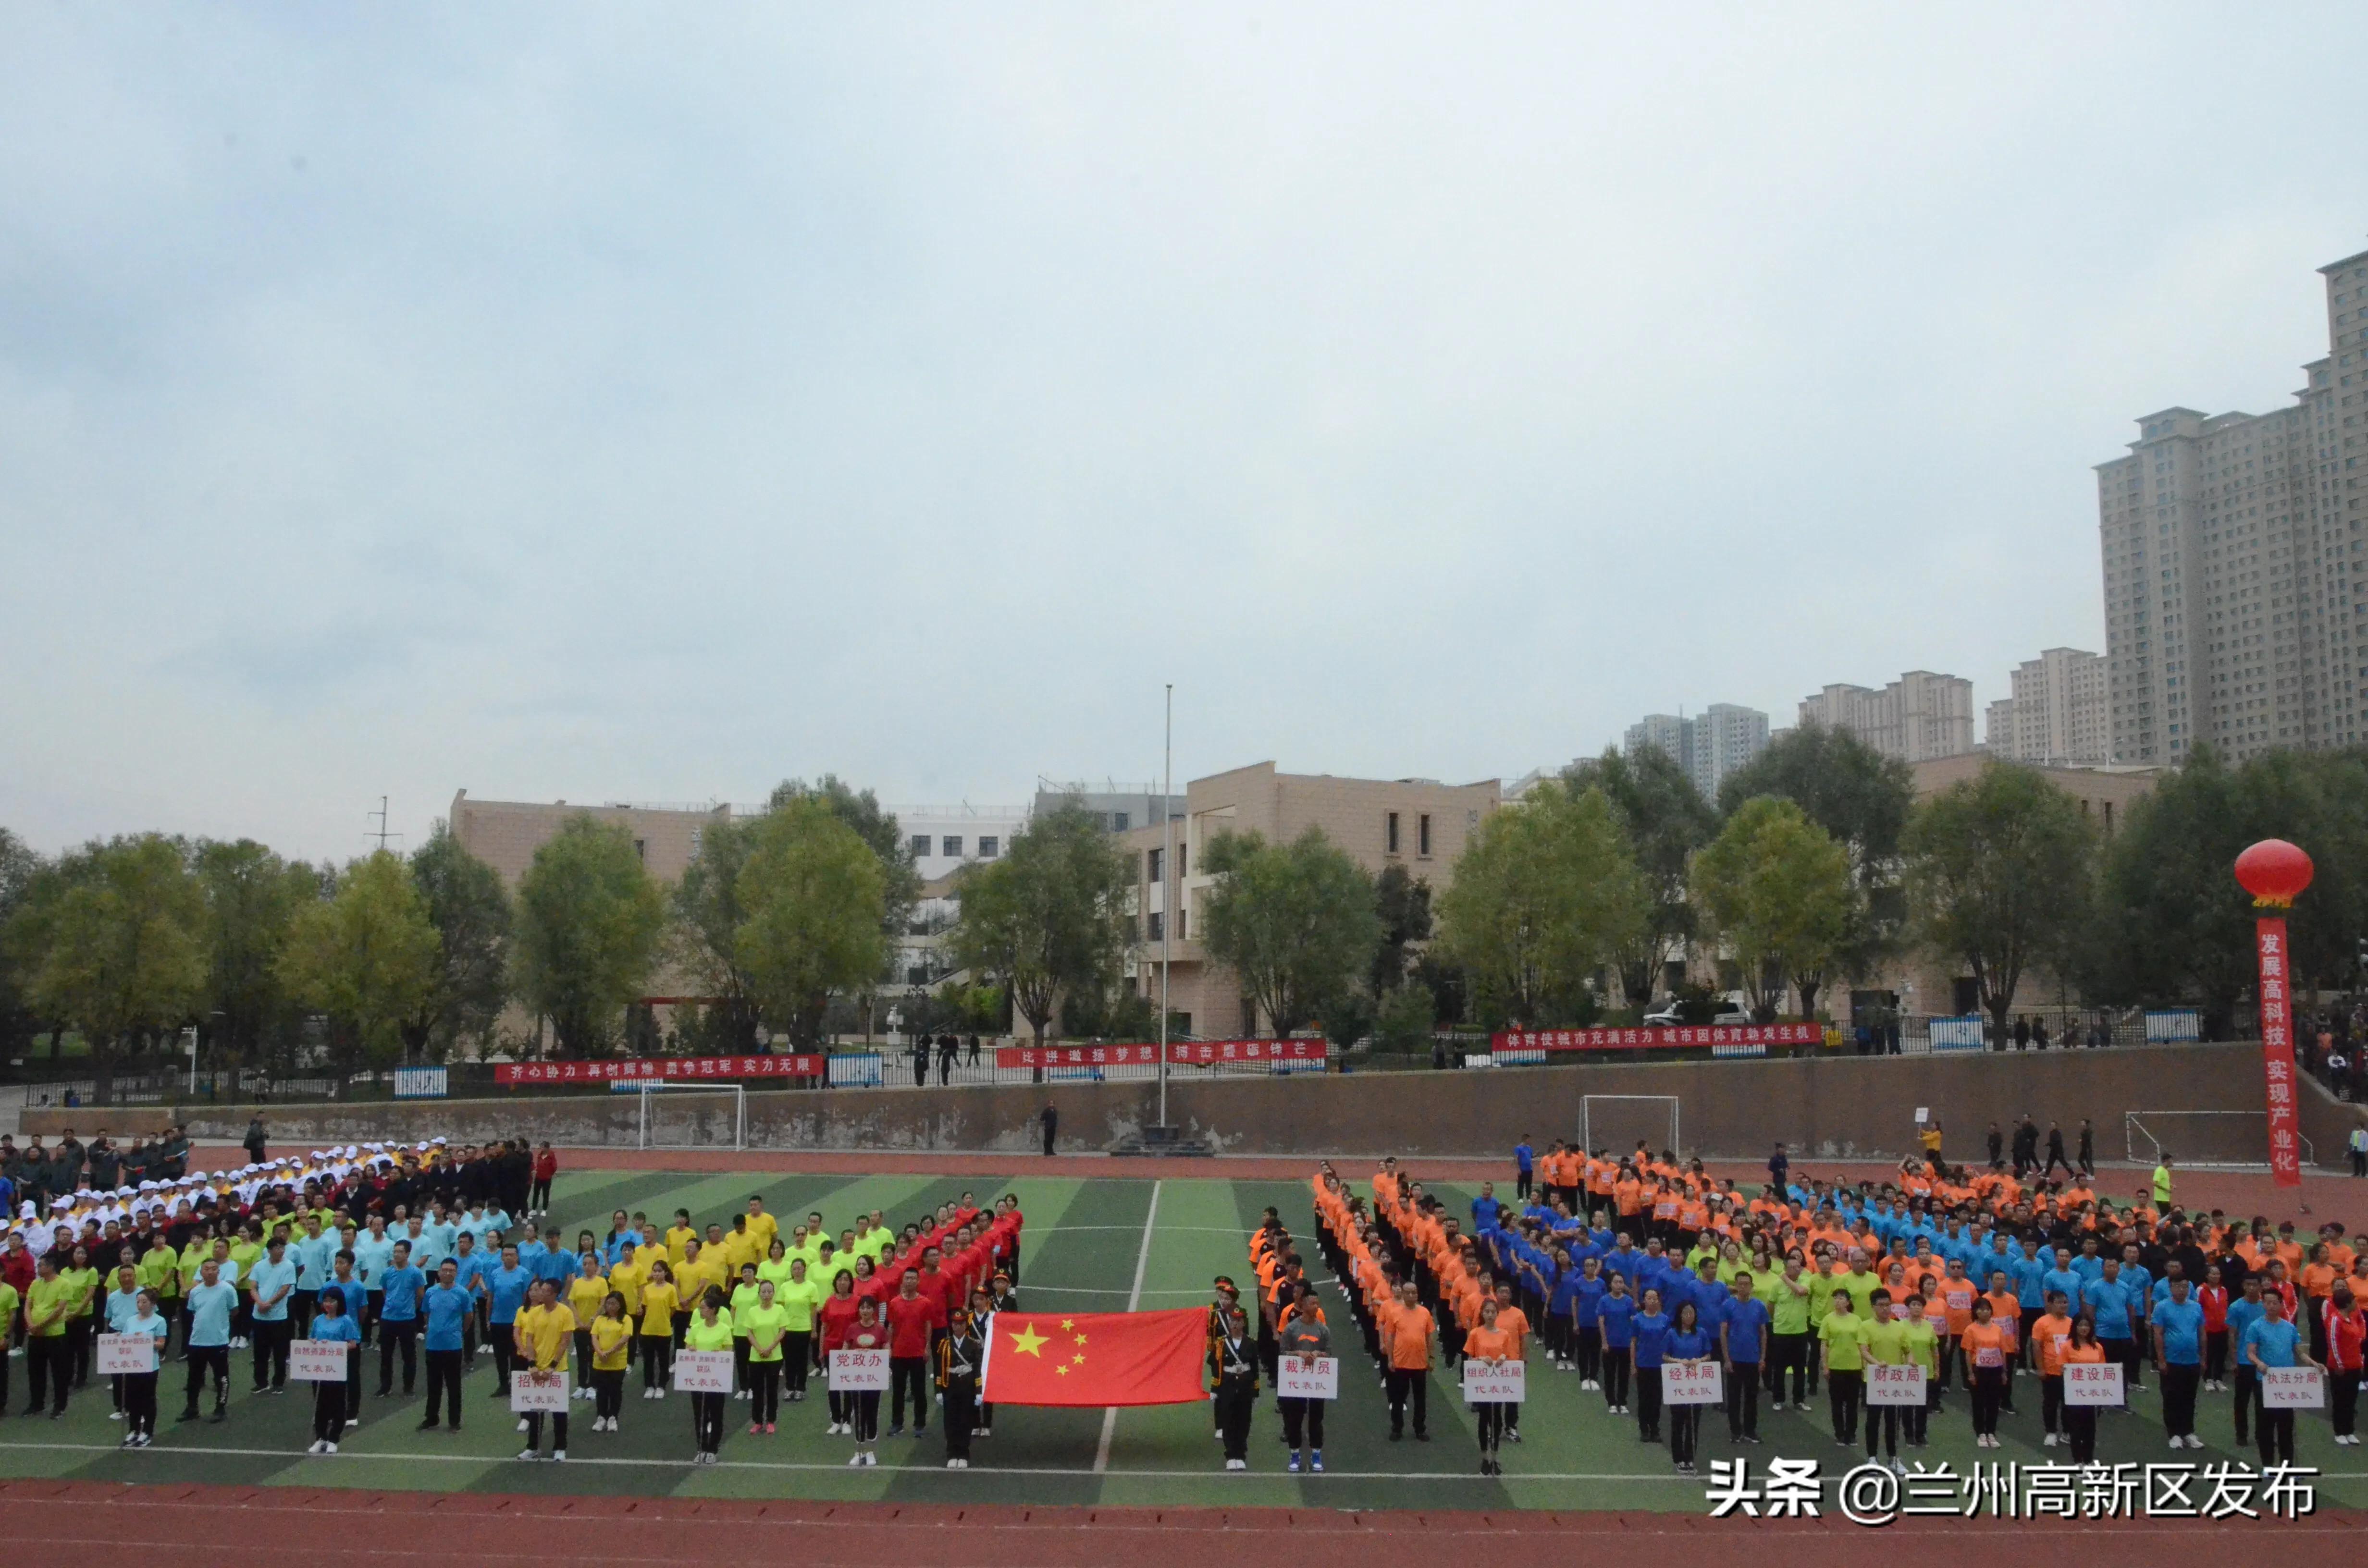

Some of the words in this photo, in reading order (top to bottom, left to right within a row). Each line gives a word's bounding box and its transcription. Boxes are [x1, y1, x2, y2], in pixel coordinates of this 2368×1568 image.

[2261, 934, 2286, 1046] 发展高科技
[1507, 1030, 1653, 1047] 体育使城市充满活力
[1663, 1026, 1809, 1042] 城市因体育勃发生机
[1023, 1046, 1152, 1063] 比拼激扬梦想
[511, 1064, 576, 1078] 齐心协力
[588, 1061, 654, 1077] 再创辉煌
[666, 1059, 731, 1075] 勇争冠军
[744, 1058, 810, 1072] 实力无限
[2267, 1059, 2295, 1171] 实现产业化
[294, 1347, 344, 1356] 自然资源分局
[108, 1360, 143, 1369] 代表队
[837, 1353, 882, 1367] 党政办
[300, 1364, 336, 1372] 代表队
[1285, 1359, 1330, 1374] 裁判员
[1467, 1367, 1521, 1377] 组织人社局
[1669, 1365, 1714, 1380] 经科局
[1875, 1368, 1920, 1382] 财政局
[2072, 1367, 2116, 1381] 建设局
[684, 1378, 722, 1387] 代表队
[840, 1374, 878, 1383] 代表队
[2268, 1372, 2318, 1384] 执法分局
[1288, 1380, 1326, 1390] 代表队
[1475, 1385, 1514, 1394] 代表队
[1674, 1387, 1712, 1396] 代表队
[1877, 1389, 1916, 1397] 代表队
[2075, 1388, 2113, 1397] 代表队
[2273, 1392, 2313, 1400] 代表队
[521, 1395, 558, 1404] 代表队
